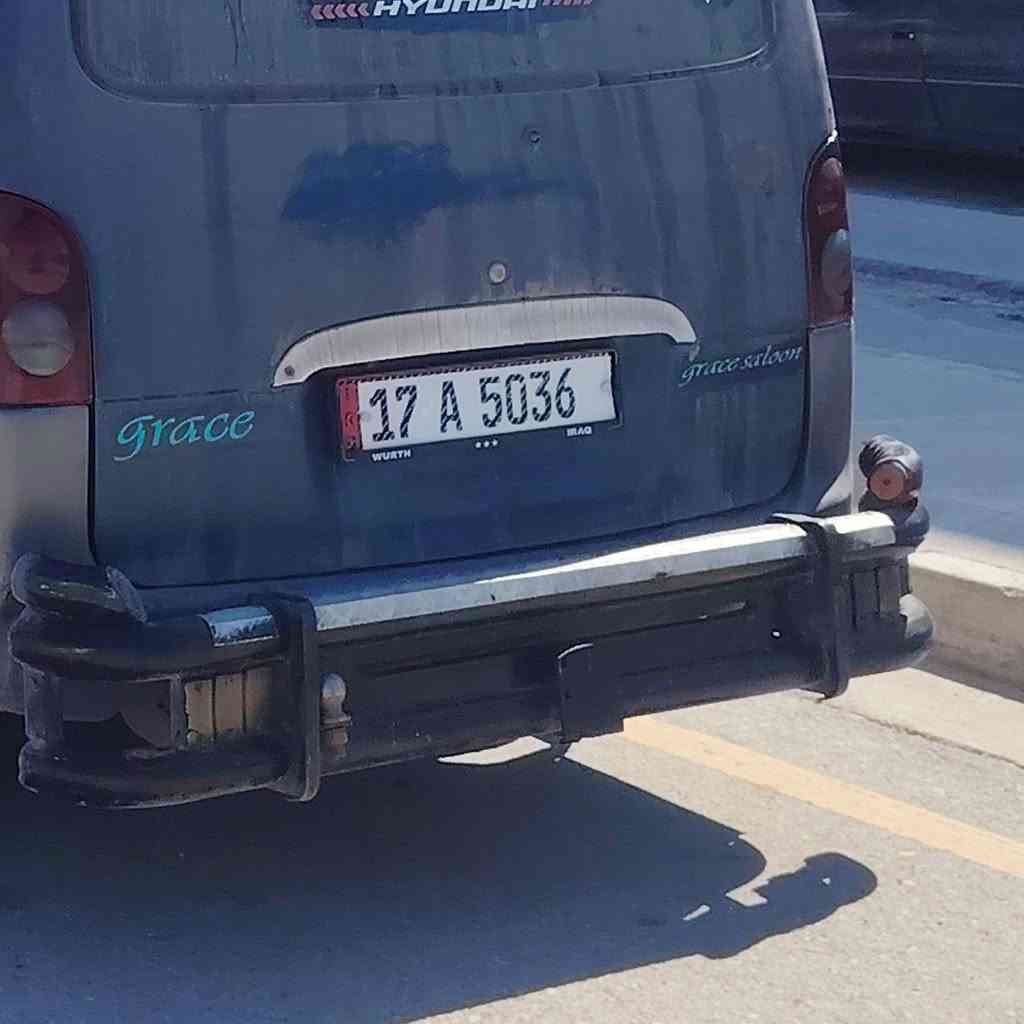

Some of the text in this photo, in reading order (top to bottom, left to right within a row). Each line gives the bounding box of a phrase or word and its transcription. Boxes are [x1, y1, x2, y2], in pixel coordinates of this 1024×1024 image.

[112, 410, 256, 462] grace
[369, 384, 417, 442] 17
[440, 380, 463, 433] A
[479, 368, 576, 428] 5036
